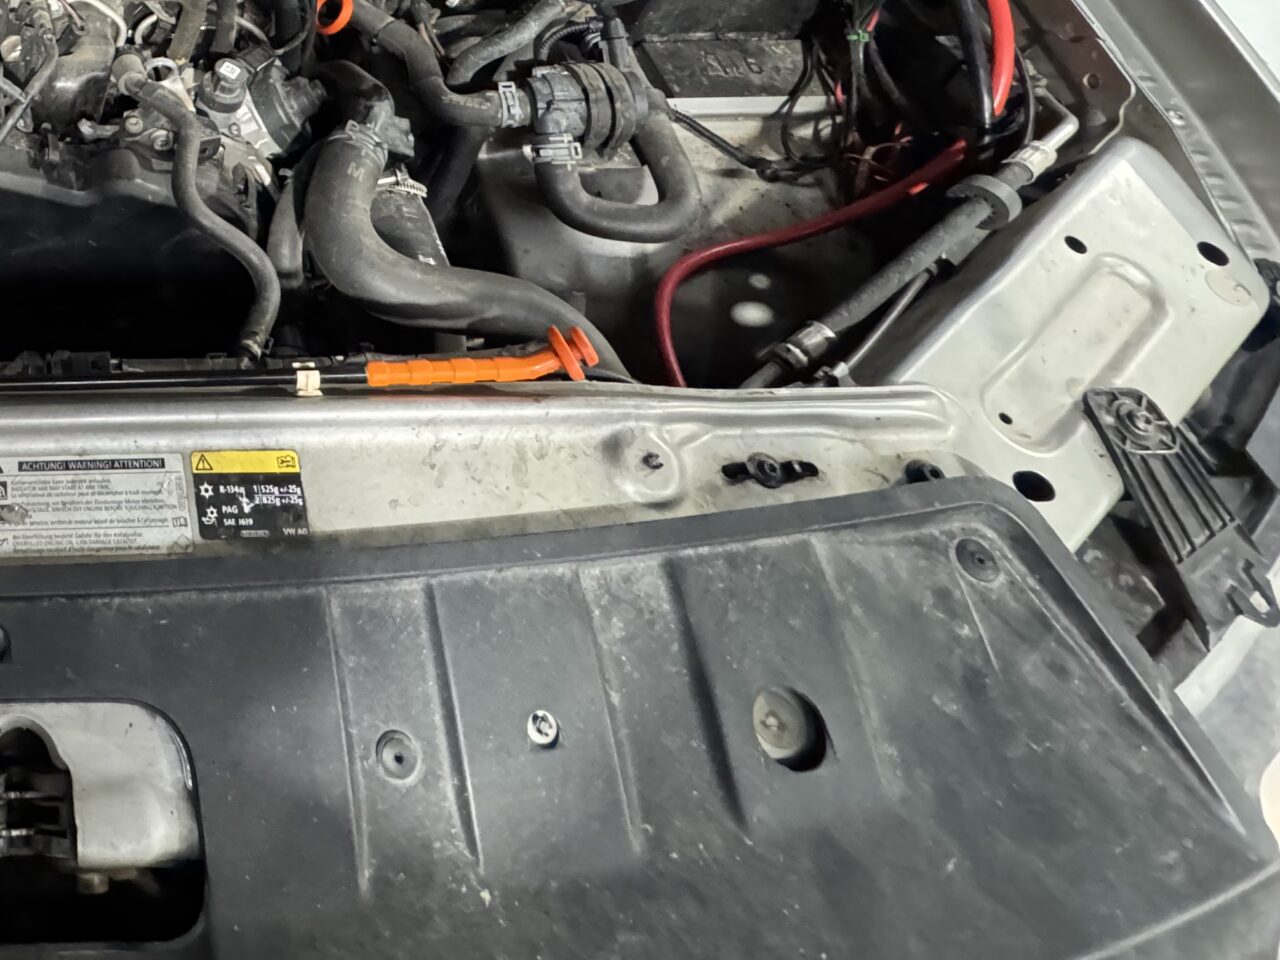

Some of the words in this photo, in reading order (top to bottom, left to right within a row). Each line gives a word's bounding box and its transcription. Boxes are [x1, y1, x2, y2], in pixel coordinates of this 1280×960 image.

[21, 462, 66, 471] ACHTUNG!
[67, 460, 112, 470] WARNING!
[113, 459, 163, 469] ATTENTION!
[221, 505, 239, 514] PAG
[223, 518, 236, 526] SAE
[282, 528, 297, 536] VW
